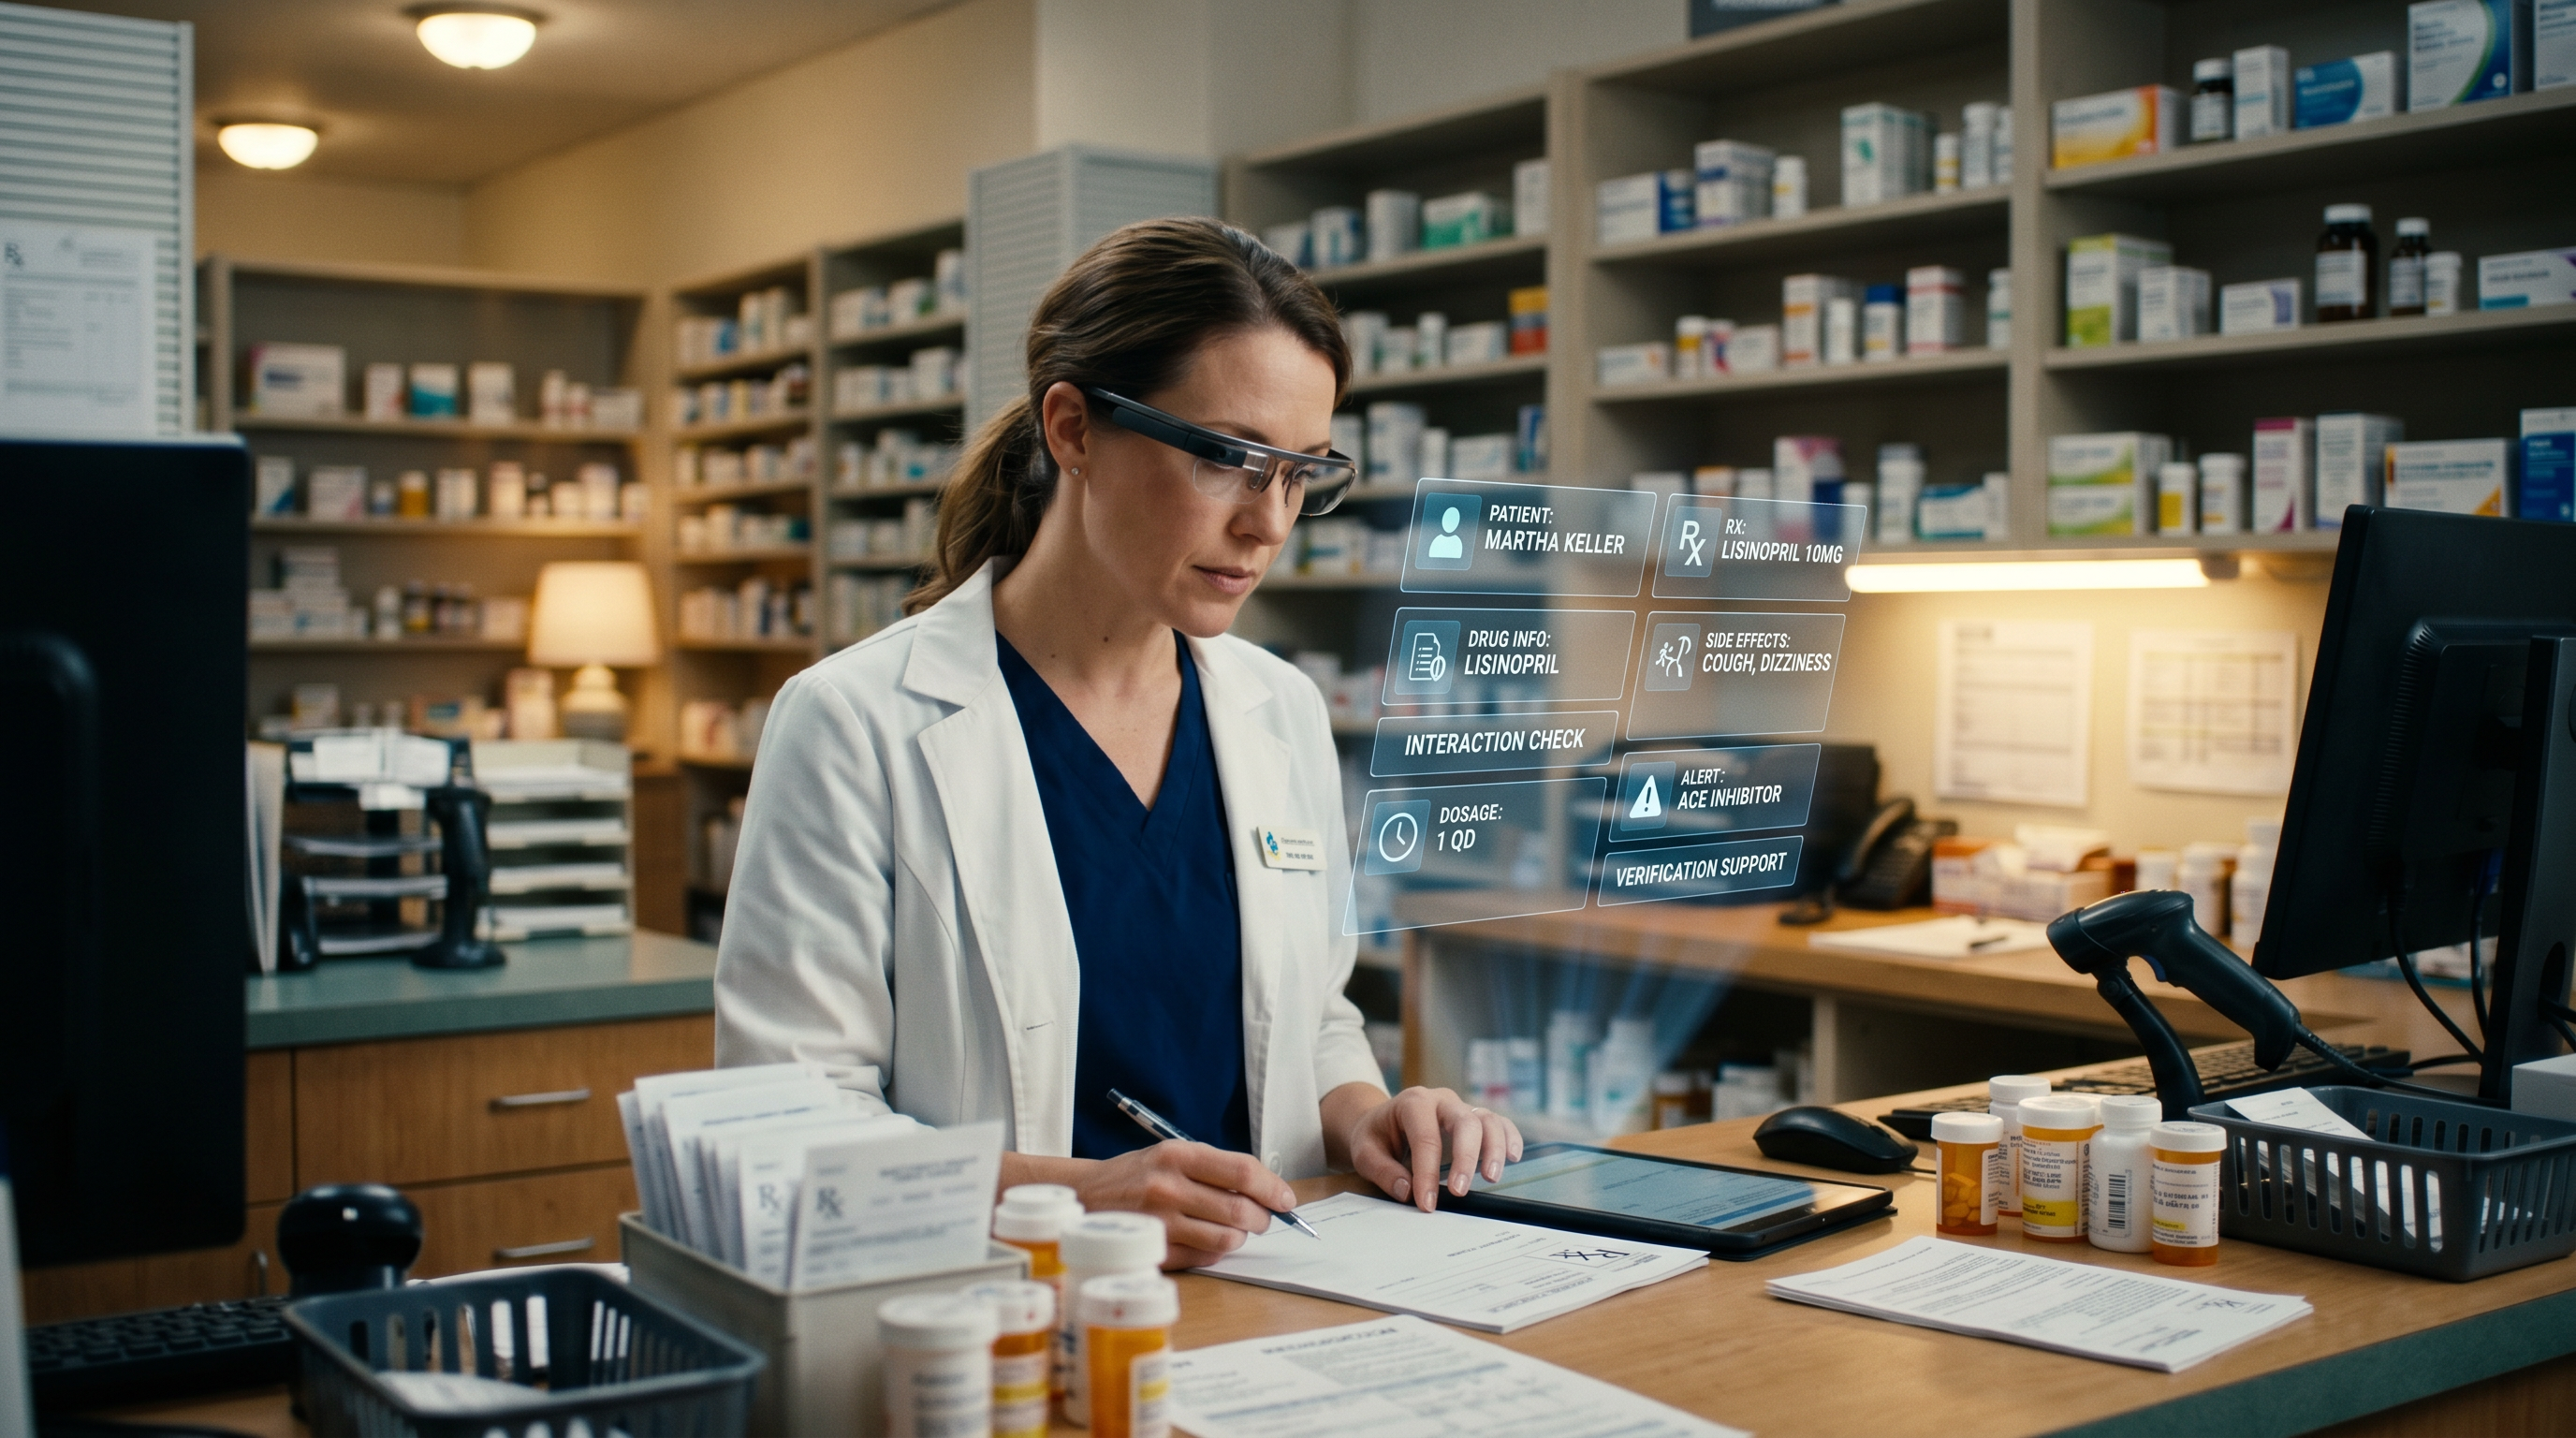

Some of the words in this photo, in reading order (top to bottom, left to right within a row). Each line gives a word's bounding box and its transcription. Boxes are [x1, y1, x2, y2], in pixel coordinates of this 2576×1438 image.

[1489, 505, 1554, 524] PATIENT:
[1725, 519, 1747, 535] RX:
[1485, 529, 1559, 552] MARTHA
[1564, 532, 1625, 554] KELLER
[1721, 540, 1800, 562] LISINOPRIL
[1806, 544, 1844, 564] 10MG
[1468, 630, 1510, 648] DRUG
[1513, 630, 1551, 648] INFO:
[1705, 632, 1734, 648] SIDE
[1735, 632, 1791, 648] EFFECTS:
[1464, 653, 1559, 675] LISINOPRIL
[1703, 653, 1756, 676] COUGH,
[1760, 653, 1832, 672] DIZZINESS
[1404, 731, 1525, 756] INTERACTION
[1529, 728, 1586, 750] CHECK
[1680, 768, 1726, 785] ALERT:
[1677, 789, 1708, 810] ACE
[1710, 785, 1782, 808] INHIBITOR
[1440, 803, 1503, 824] DOSAGE:
[1437, 830, 1445, 851] 1
[1451, 829, 1476, 852] QD
[1617, 858, 1718, 887] VERIFICATION
[1720, 852, 1788, 875] SUPPORT
